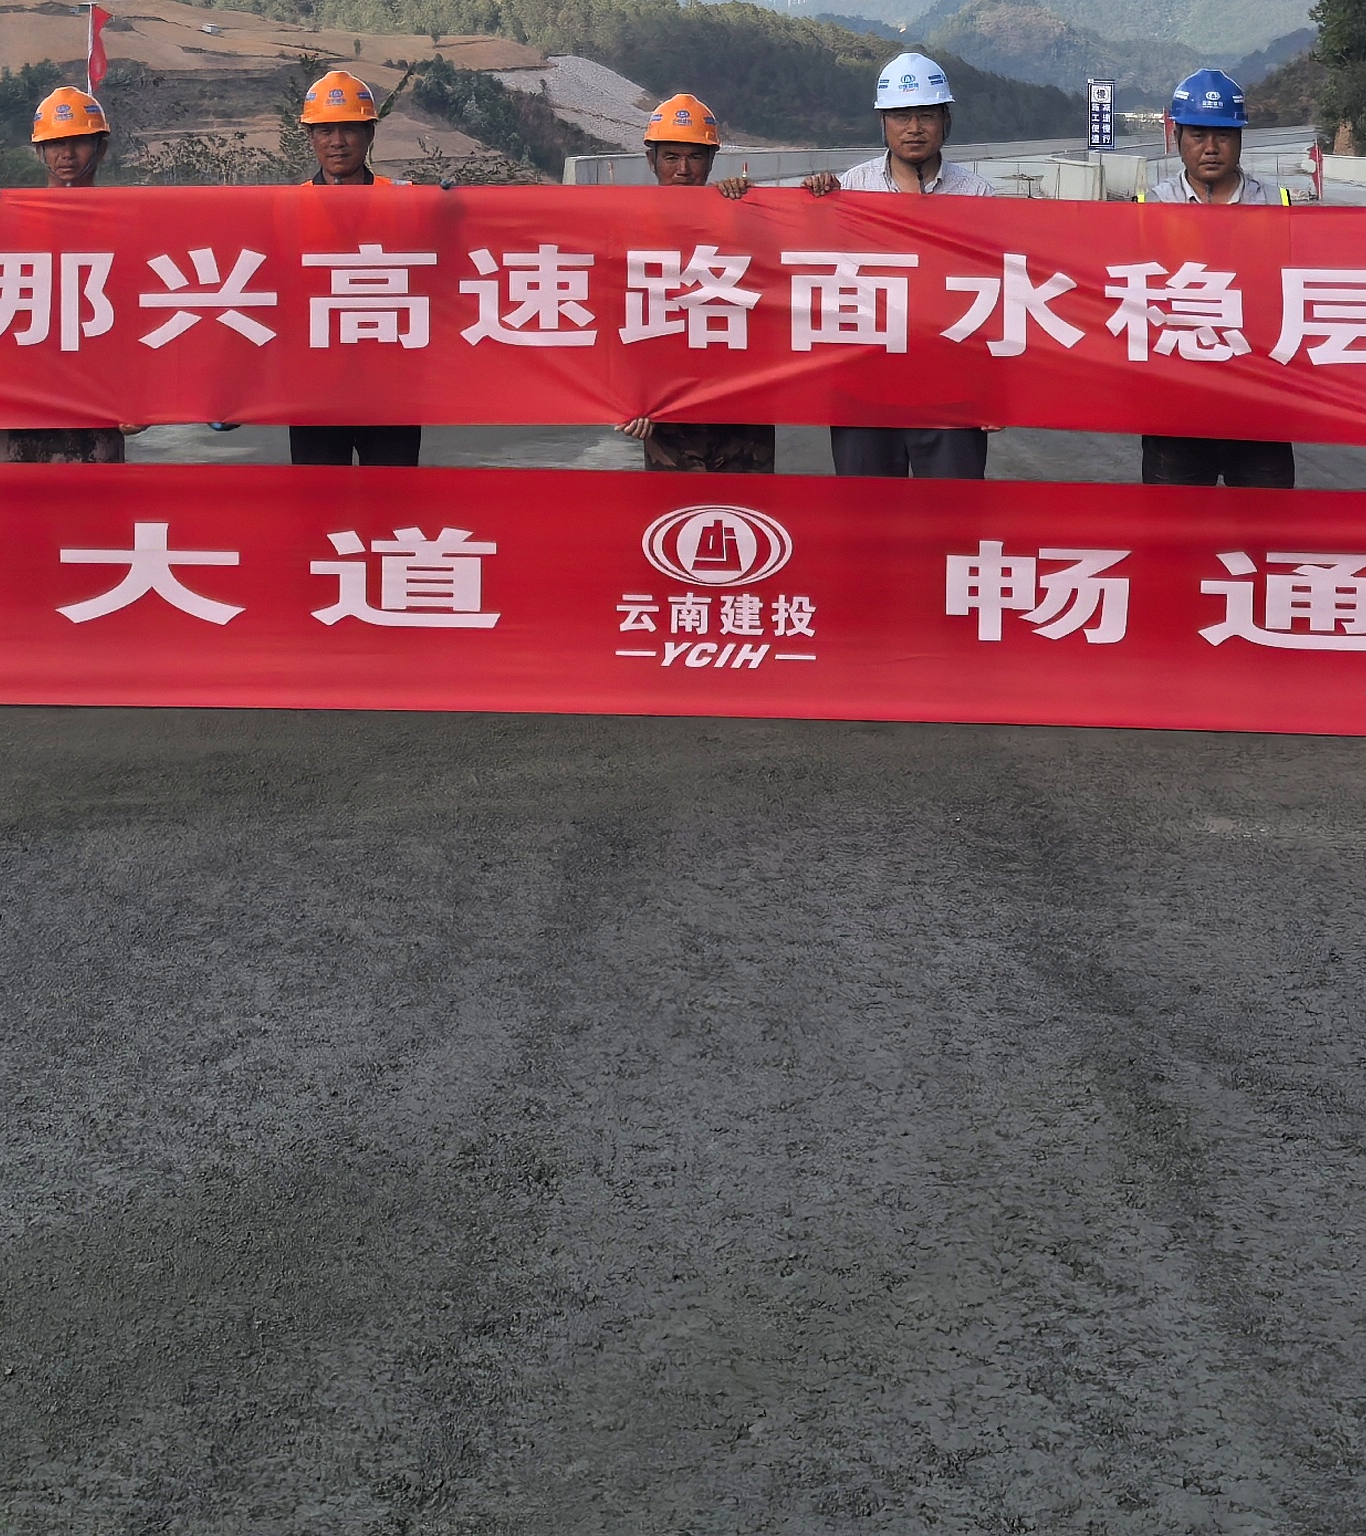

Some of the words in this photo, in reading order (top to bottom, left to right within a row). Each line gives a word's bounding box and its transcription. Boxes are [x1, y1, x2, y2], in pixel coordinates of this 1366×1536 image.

[616, 592, 817, 637] 云南建投
[661, 641, 768, 670] YCIH
